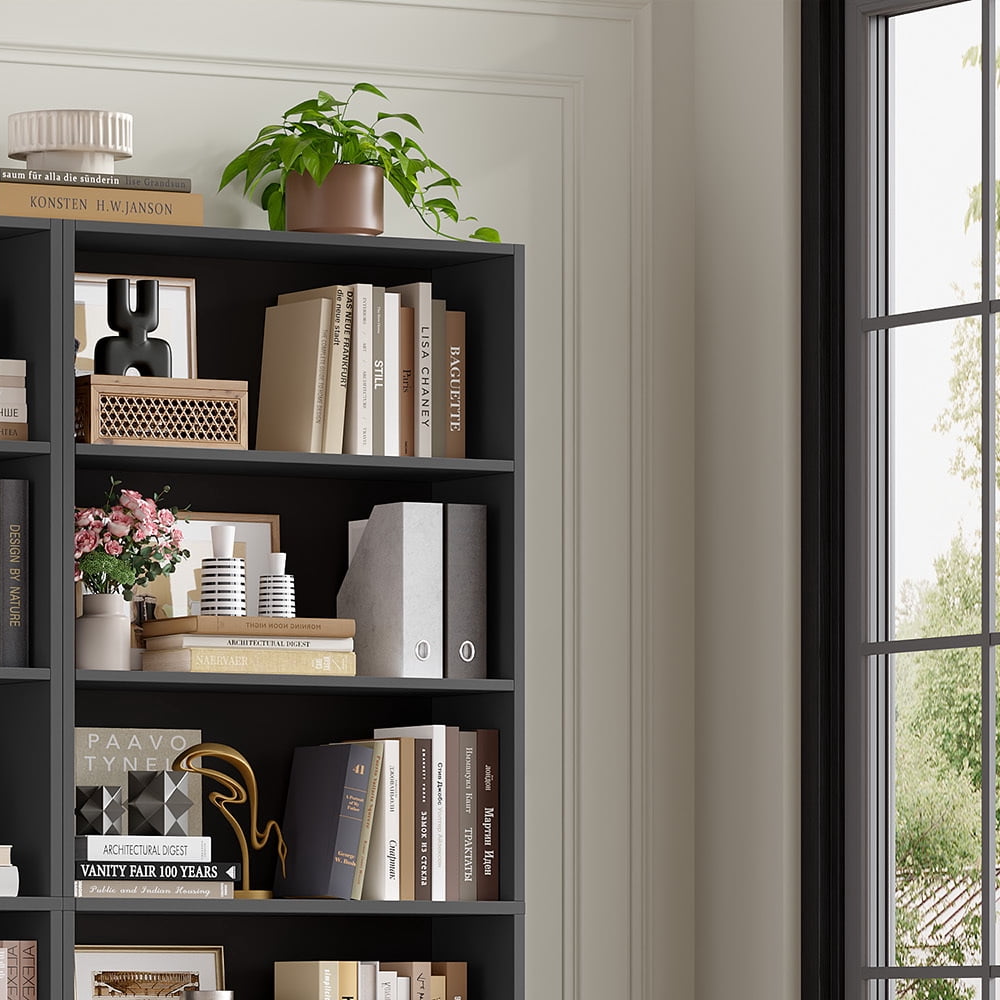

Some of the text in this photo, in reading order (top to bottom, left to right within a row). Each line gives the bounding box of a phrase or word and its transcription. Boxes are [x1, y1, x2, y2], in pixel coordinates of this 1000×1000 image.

[2, 171, 26, 180] saum
[44, 172, 62, 182] alla
[63, 173, 78, 182] die
[80, 174, 120, 185] sünderin
[30, 196, 88, 211] KONSTEN
[333, 325, 341, 345] stadt
[340, 291, 353, 388] DAS NEUE FRANKFURT
[374, 360, 383, 390] STILL
[402, 369, 411, 392] Paris
[421, 326, 429, 427] LISA CHANEY
[450, 346, 461, 431] BAGUETTE
[9, 524, 21, 627] DESIGN BY NATURE
[226, 639, 284, 647] ARCHITECTURAL
[88, 733, 187, 751] PAAVO
[465, 793, 473, 813] Кант
[102, 845, 161, 856] ARCHITECTURAL
[162, 845, 188, 856] DIGEST
[482, 807, 494, 876] Мартин Иден
[464, 828, 473, 881] ТРАКТАТЫ
[80, 864, 218, 878] VANITY FAIR 100 YEARS
[89, 885, 116, 894] Public
[120, 885, 137, 894] and
